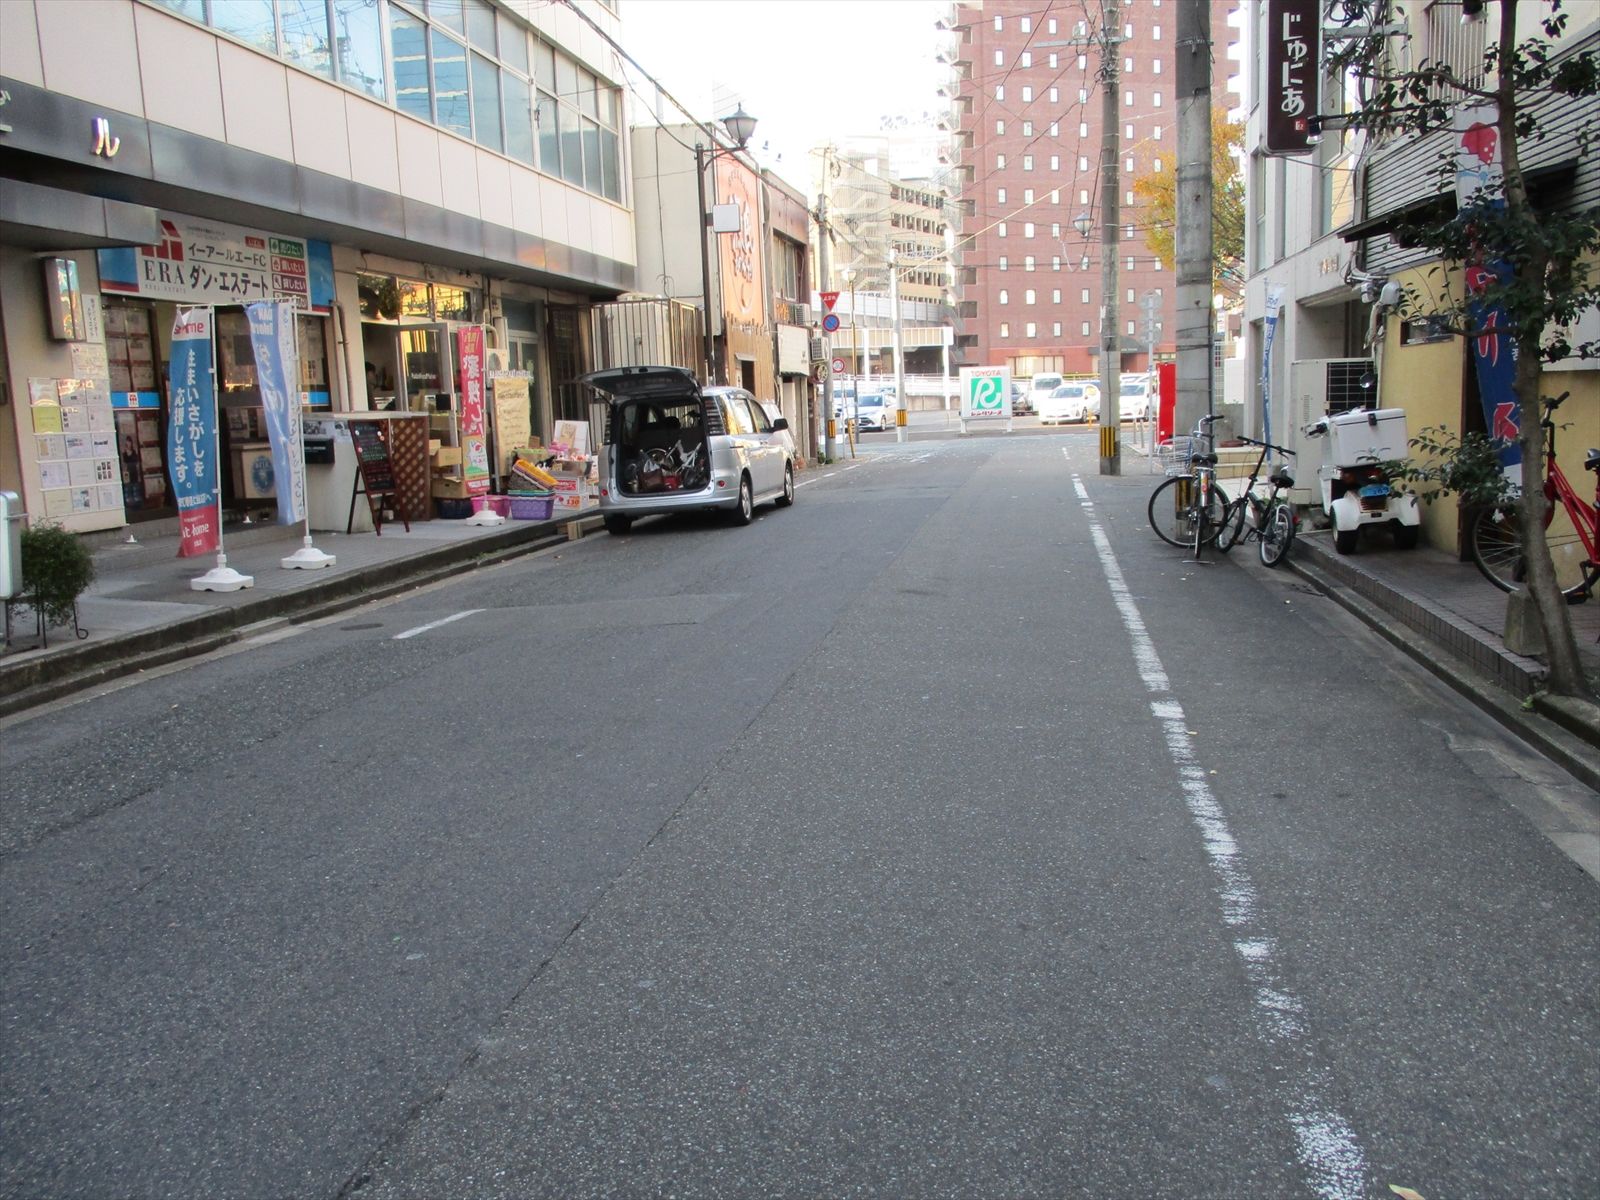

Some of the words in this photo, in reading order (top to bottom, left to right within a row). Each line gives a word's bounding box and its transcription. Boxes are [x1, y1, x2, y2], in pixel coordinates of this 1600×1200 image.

[1281, 12, 1308, 118] じゅにあ
[188, 242, 267, 267] イーアールエーFC
[144, 259, 185, 285] ERA
[190, 264, 269, 297] ダン・エステート
[971, 369, 1002, 377] TOYOTA
